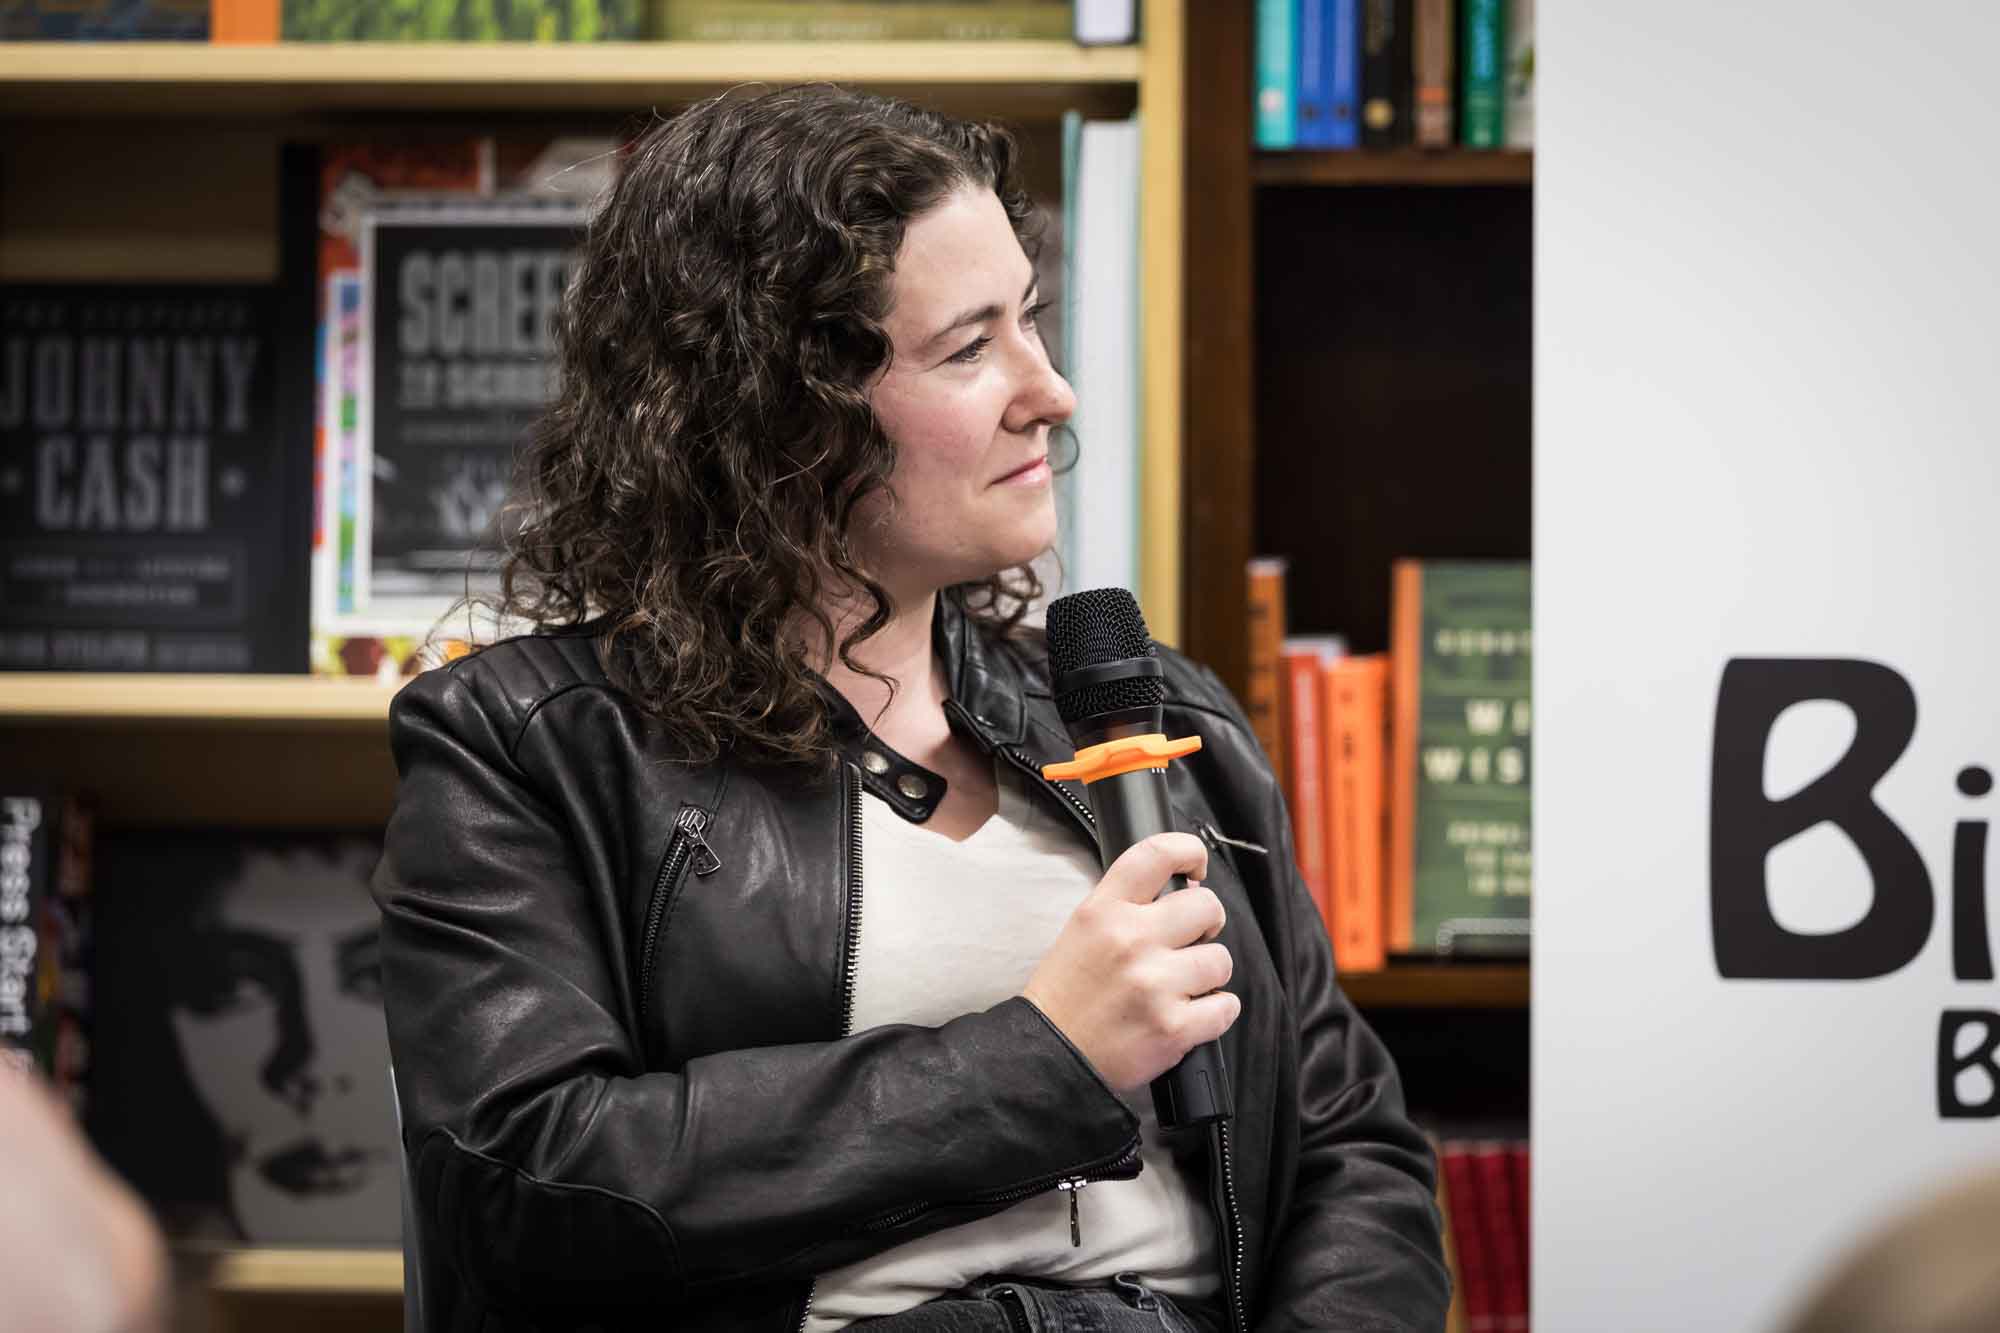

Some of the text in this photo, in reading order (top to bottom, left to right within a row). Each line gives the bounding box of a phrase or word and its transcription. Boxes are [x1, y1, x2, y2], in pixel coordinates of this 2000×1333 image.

[0, 335, 257, 430] JOHNNY
[37, 437, 207, 529] CASH
[0, 797, 41, 922] Press
[0, 925, 37, 1035] Start
